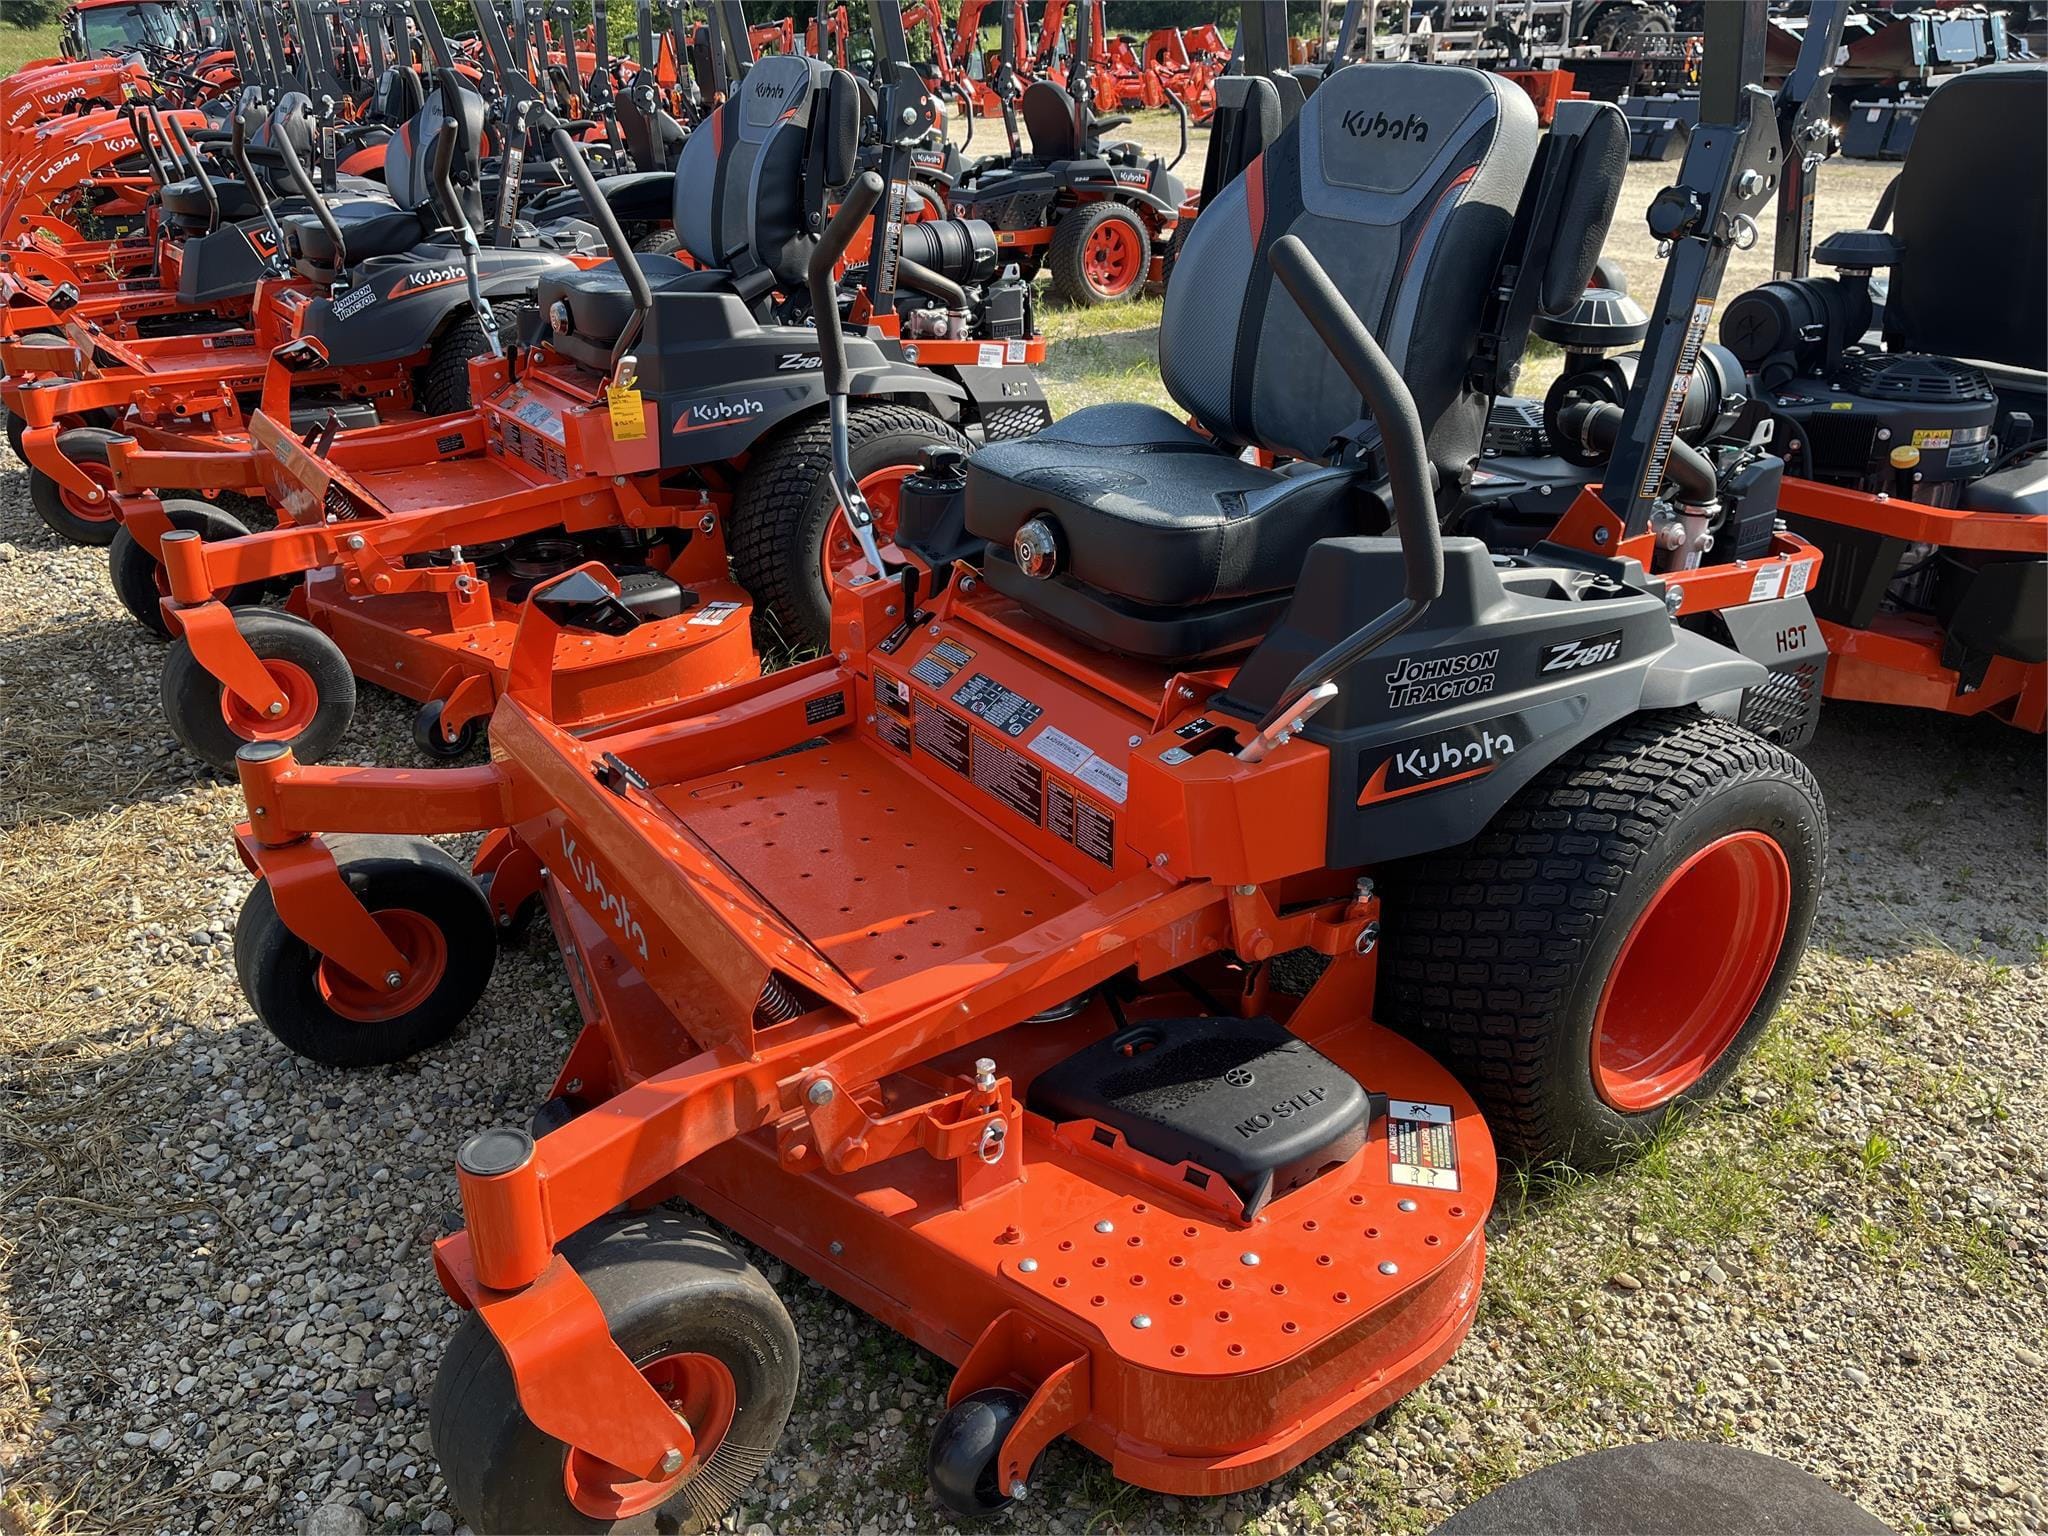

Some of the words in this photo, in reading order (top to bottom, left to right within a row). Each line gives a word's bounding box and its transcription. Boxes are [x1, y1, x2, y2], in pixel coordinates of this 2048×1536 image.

[43, 87, 87, 105] Kubota
[755, 82, 784, 99] Kubota
[7, 102, 33, 126] LA526
[1341, 110, 1429, 142] Kubota
[40, 152, 81, 184] LA344
[917, 154, 941, 164] Kubota
[1120, 171, 1146, 184] Kubota
[409, 266, 466, 286] Kubota
[1001, 382, 1028, 396] HOT
[693, 399, 764, 421] Kubota
[1776, 624, 1808, 654] HOT
[1542, 639, 1621, 672] Z781i
[1396, 731, 1515, 777] Kubota
[560, 827, 648, 961] Kubota
[1234, 1113, 1274, 1139] NO
[1272, 1086, 1328, 1120] STEP
[1388, 1123, 1397, 1146] DANGER
[1421, 1128, 1430, 1158] PELIGRO
